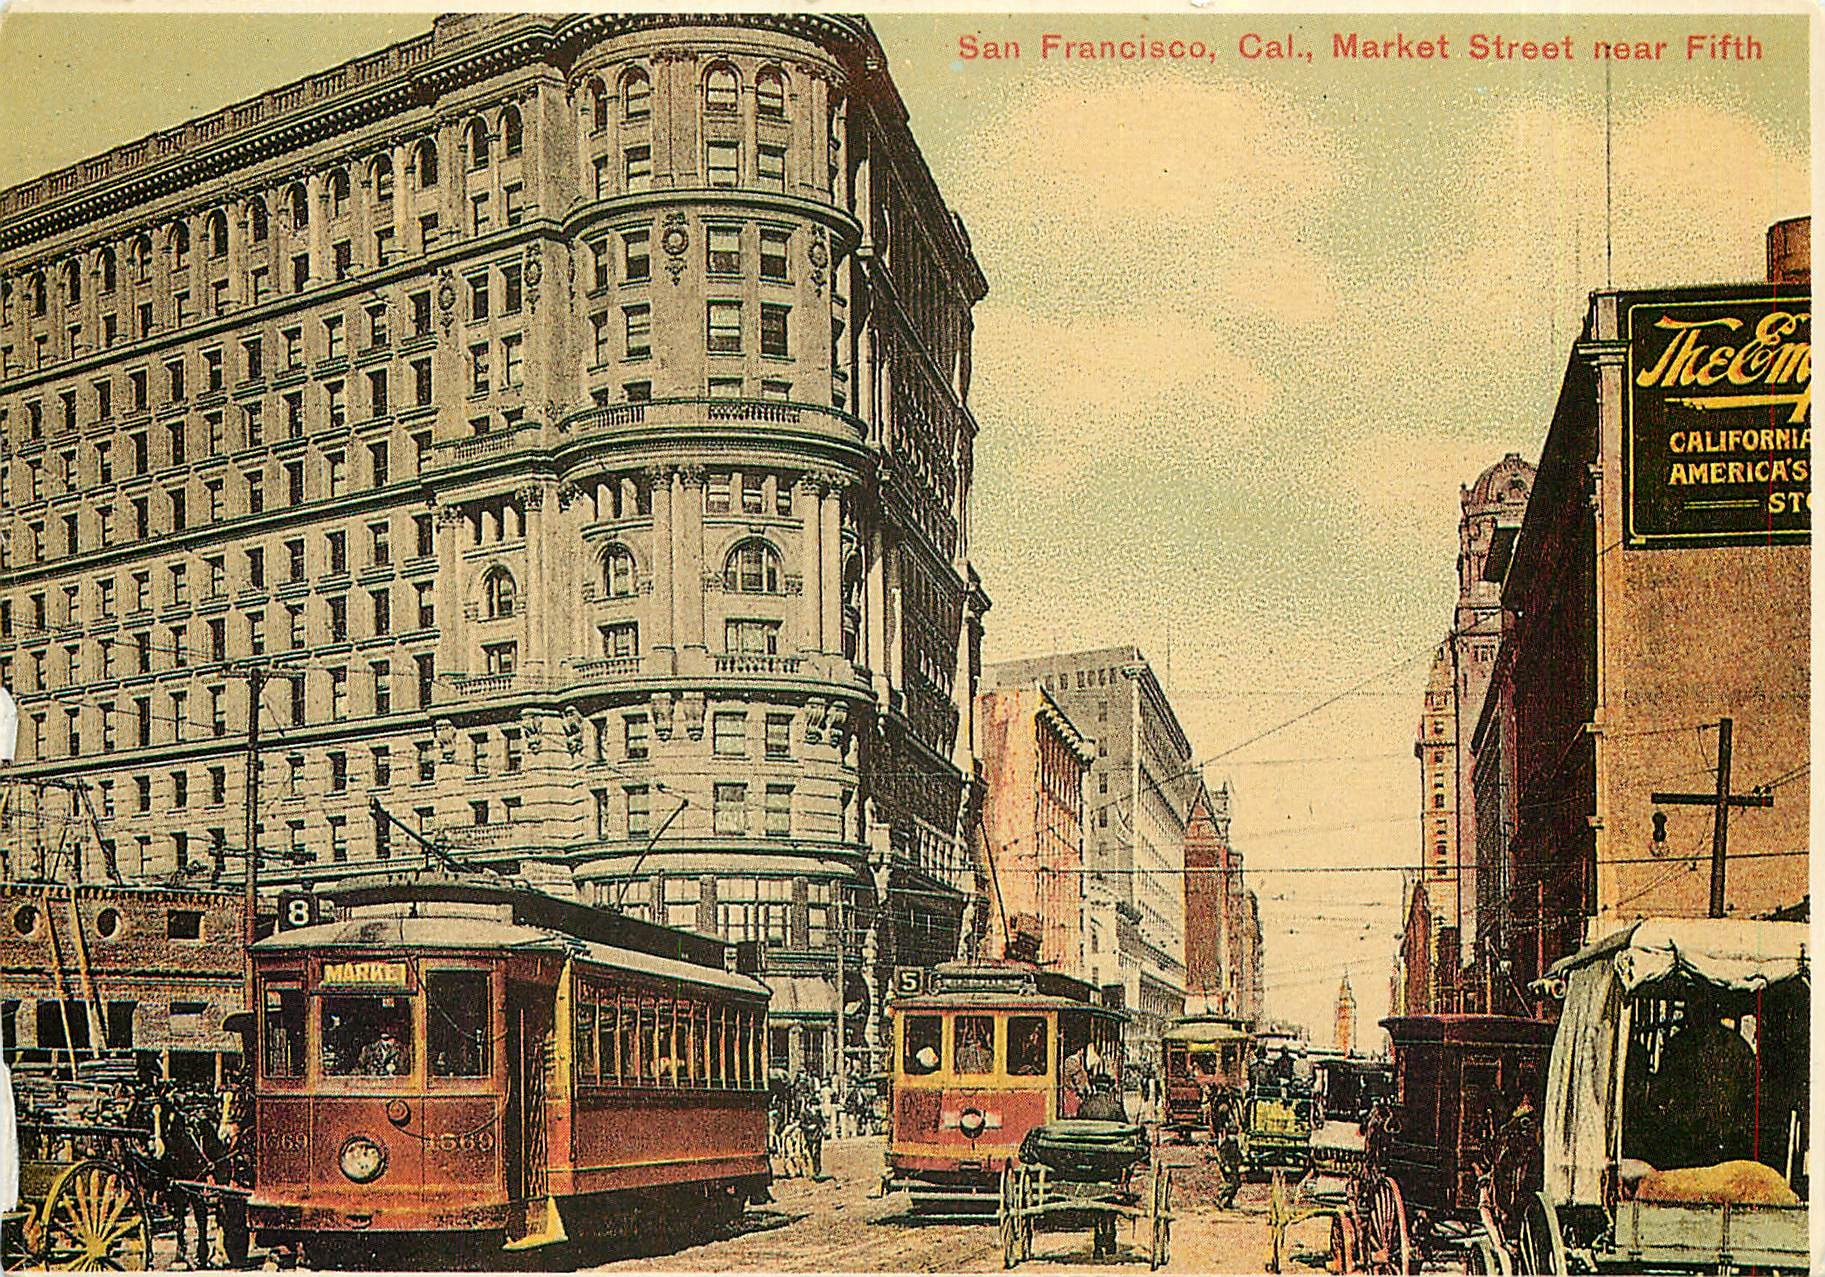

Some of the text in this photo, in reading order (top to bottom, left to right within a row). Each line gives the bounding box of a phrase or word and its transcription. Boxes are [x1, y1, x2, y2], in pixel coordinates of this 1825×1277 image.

[1635, 315, 1743, 387] The
[1669, 428, 1811, 453] CALIFORNIA
[1668, 457, 1808, 485] AMERICA'S
[288, 899, 310, 926] 8
[901, 971, 918, 991] 5
